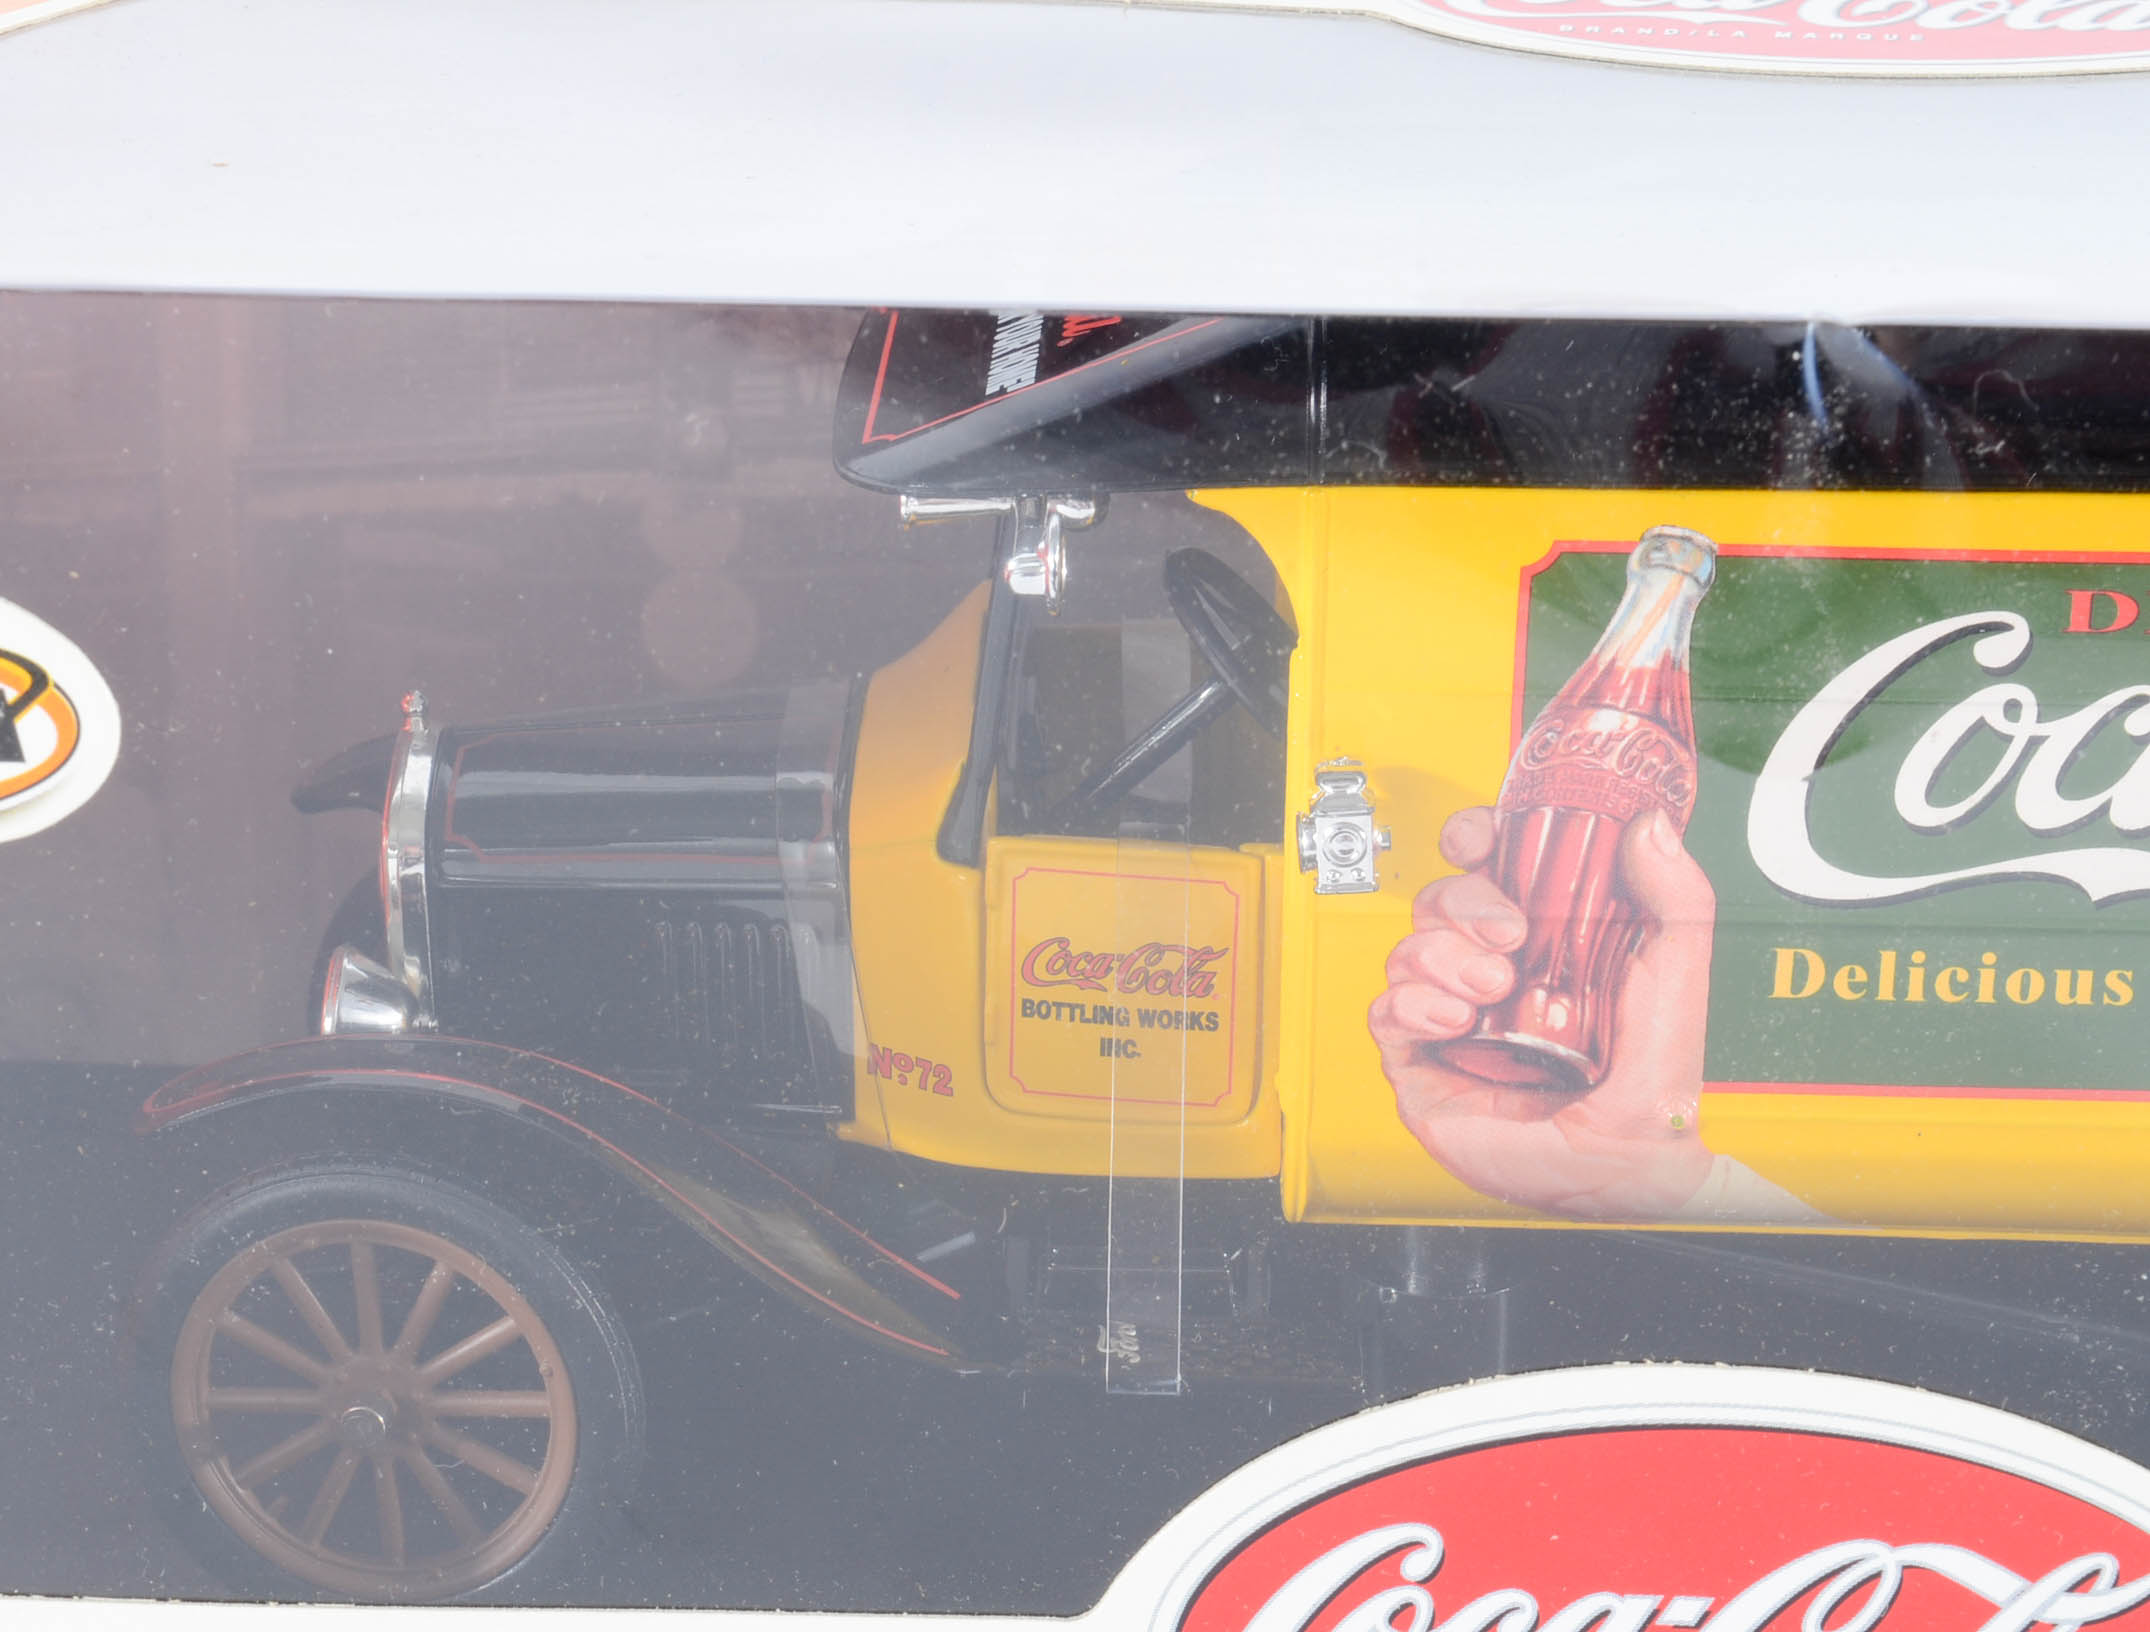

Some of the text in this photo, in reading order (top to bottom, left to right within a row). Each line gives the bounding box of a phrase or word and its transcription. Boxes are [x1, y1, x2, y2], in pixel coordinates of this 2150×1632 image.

[1774, 30, 1926, 42] MARQUE
[1767, 946, 2135, 1006] Delicious
[1021, 998, 1220, 1032] BOTTLING WORKS
